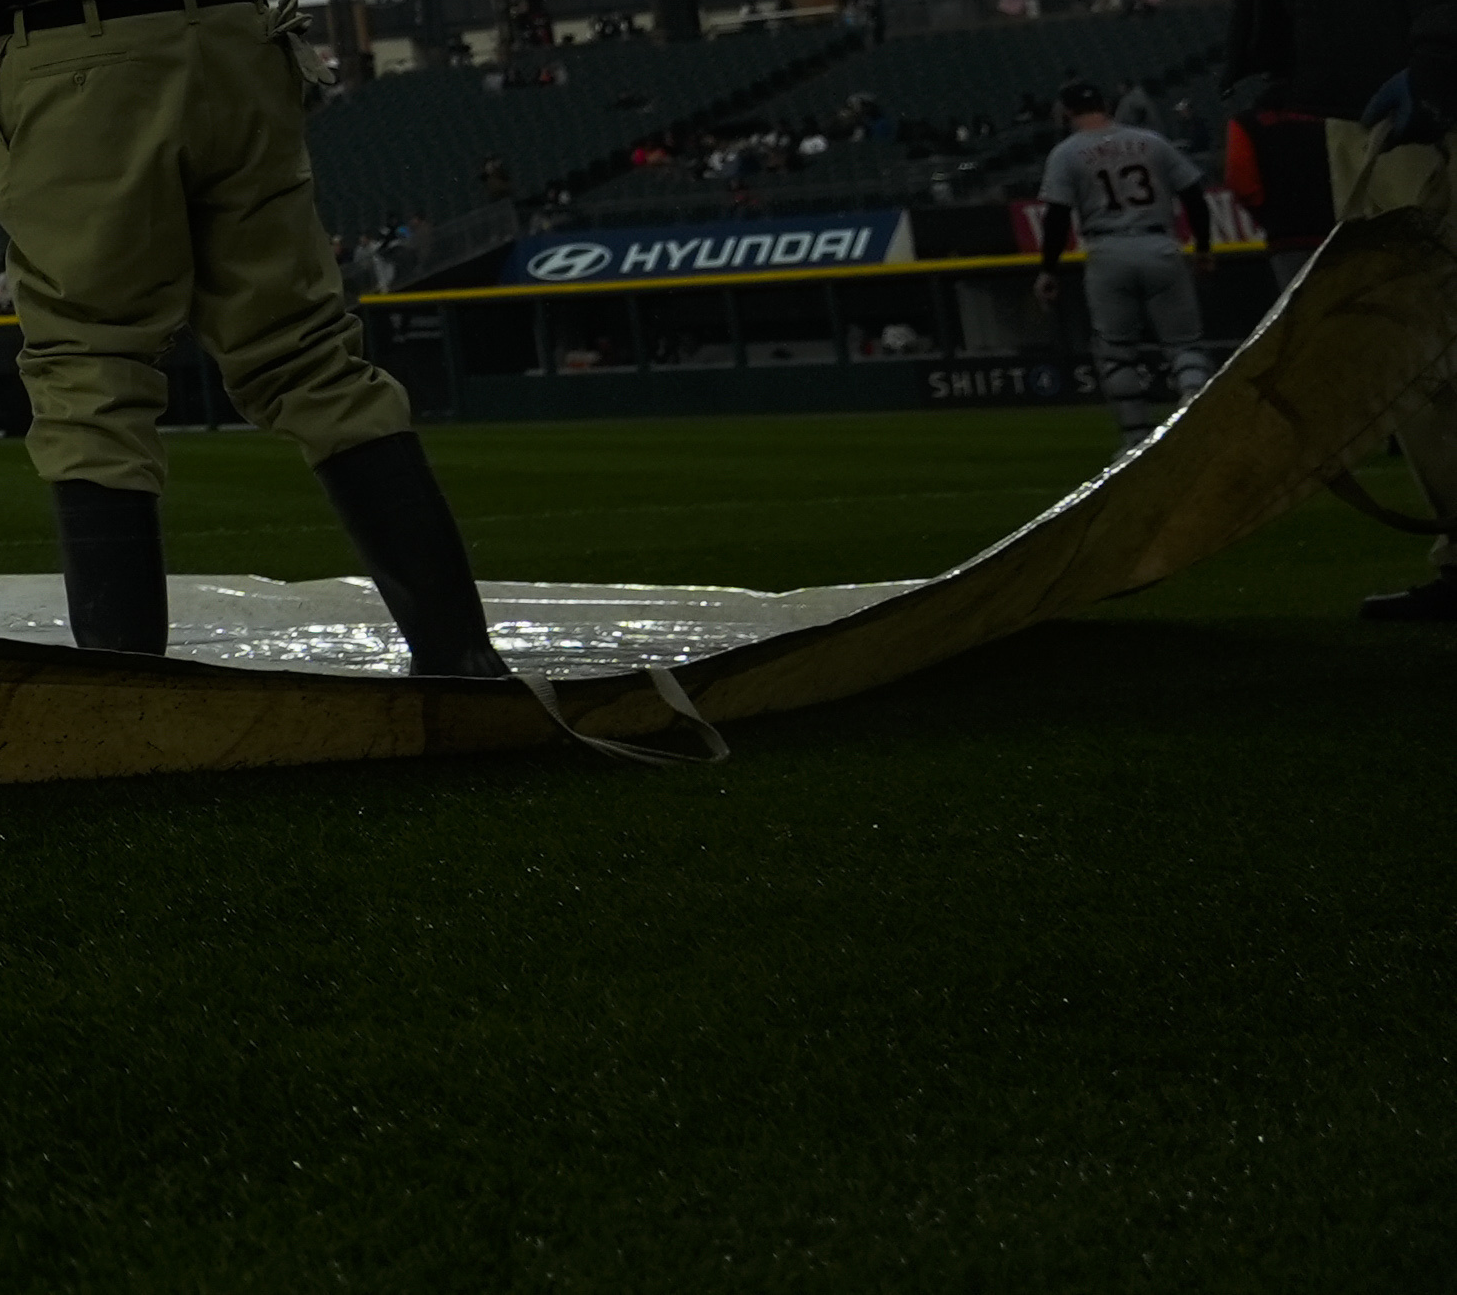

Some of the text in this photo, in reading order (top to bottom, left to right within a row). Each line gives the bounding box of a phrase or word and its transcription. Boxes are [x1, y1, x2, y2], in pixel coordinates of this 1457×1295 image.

[1097, 165, 1155, 210] 13
[620, 225, 873, 275] HYUNDAI
[928, 367, 1026, 398] SHIFT
